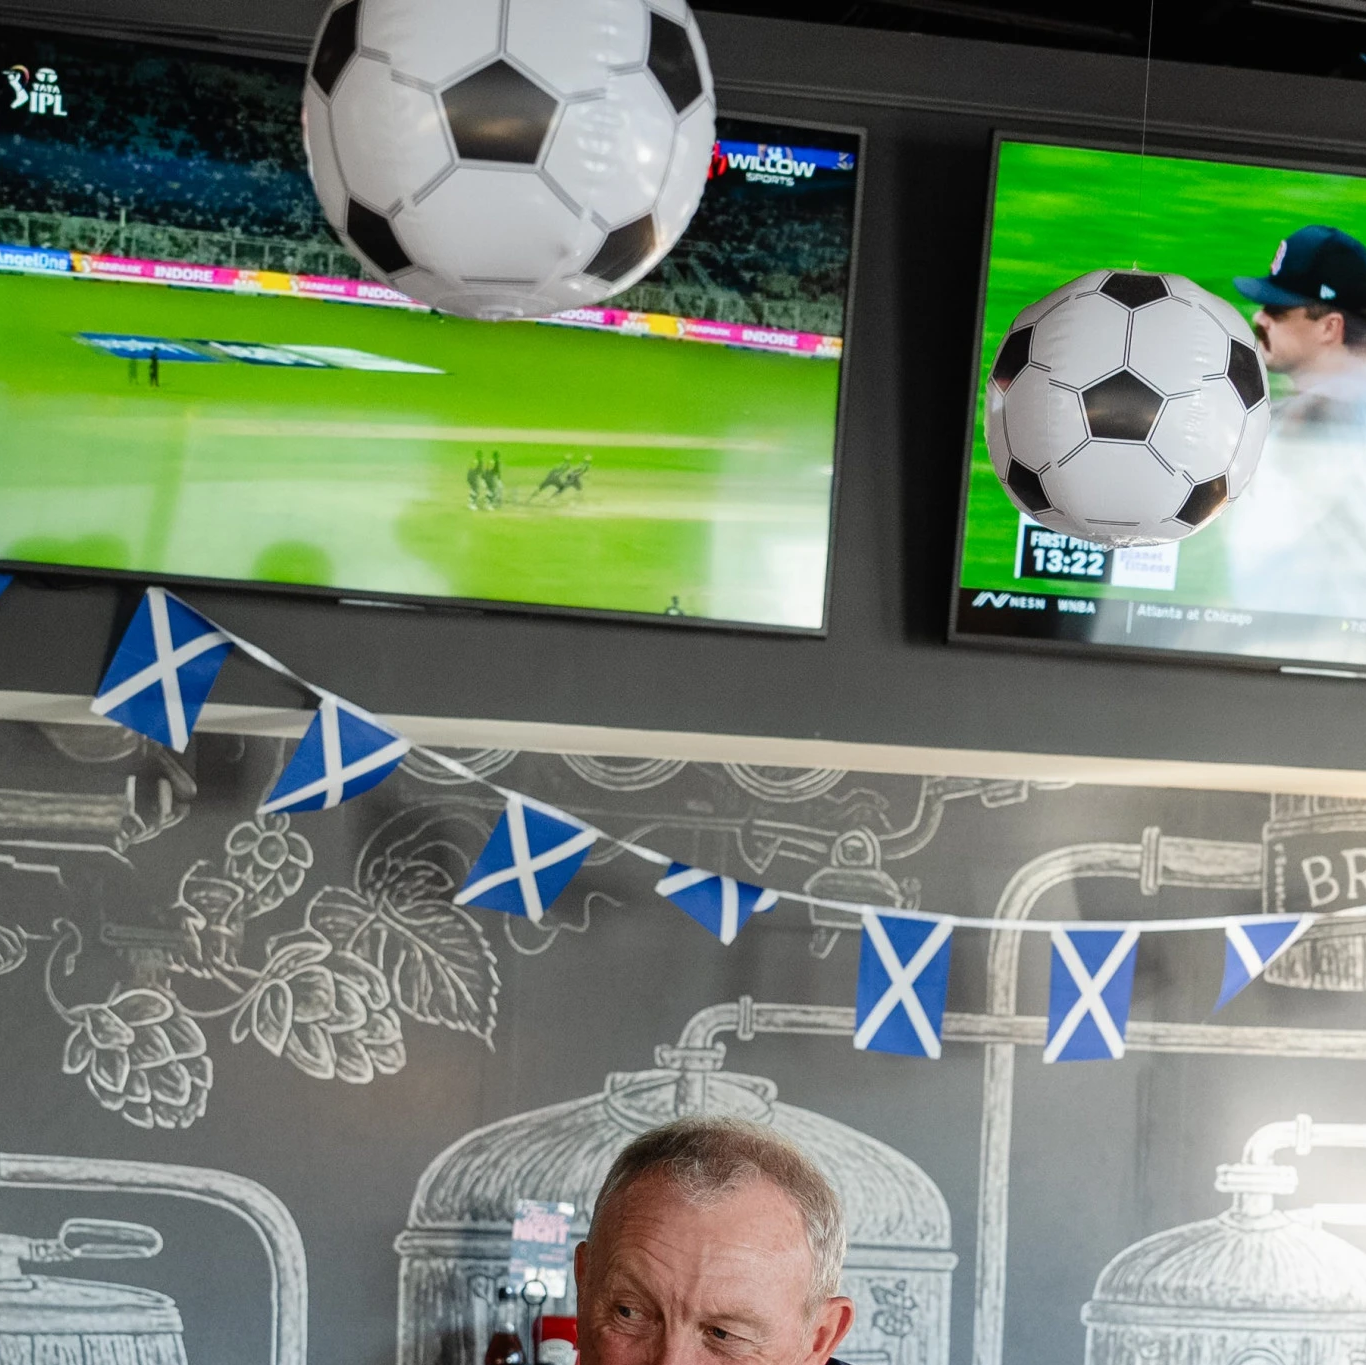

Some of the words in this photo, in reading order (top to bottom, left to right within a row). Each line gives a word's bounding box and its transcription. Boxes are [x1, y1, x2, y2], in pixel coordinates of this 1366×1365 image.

[29, 91, 68, 117] IPL
[727, 151, 816, 178] WILLOW
[745, 172, 795, 187] SPORTS
[153, 265, 214, 283] INDORE
[741, 329, 799, 348] INDORE
[1029, 530, 1068, 550] FIRST
[1032, 548, 1105, 576] 13:22
[1008, 596, 1047, 611] NESN
[1057, 598, 1096, 615] WNBA
[1136, 603, 1183, 620] Atlanta
[1187, 608, 1199, 621] at
[1204, 609, 1253, 627] Chicago
